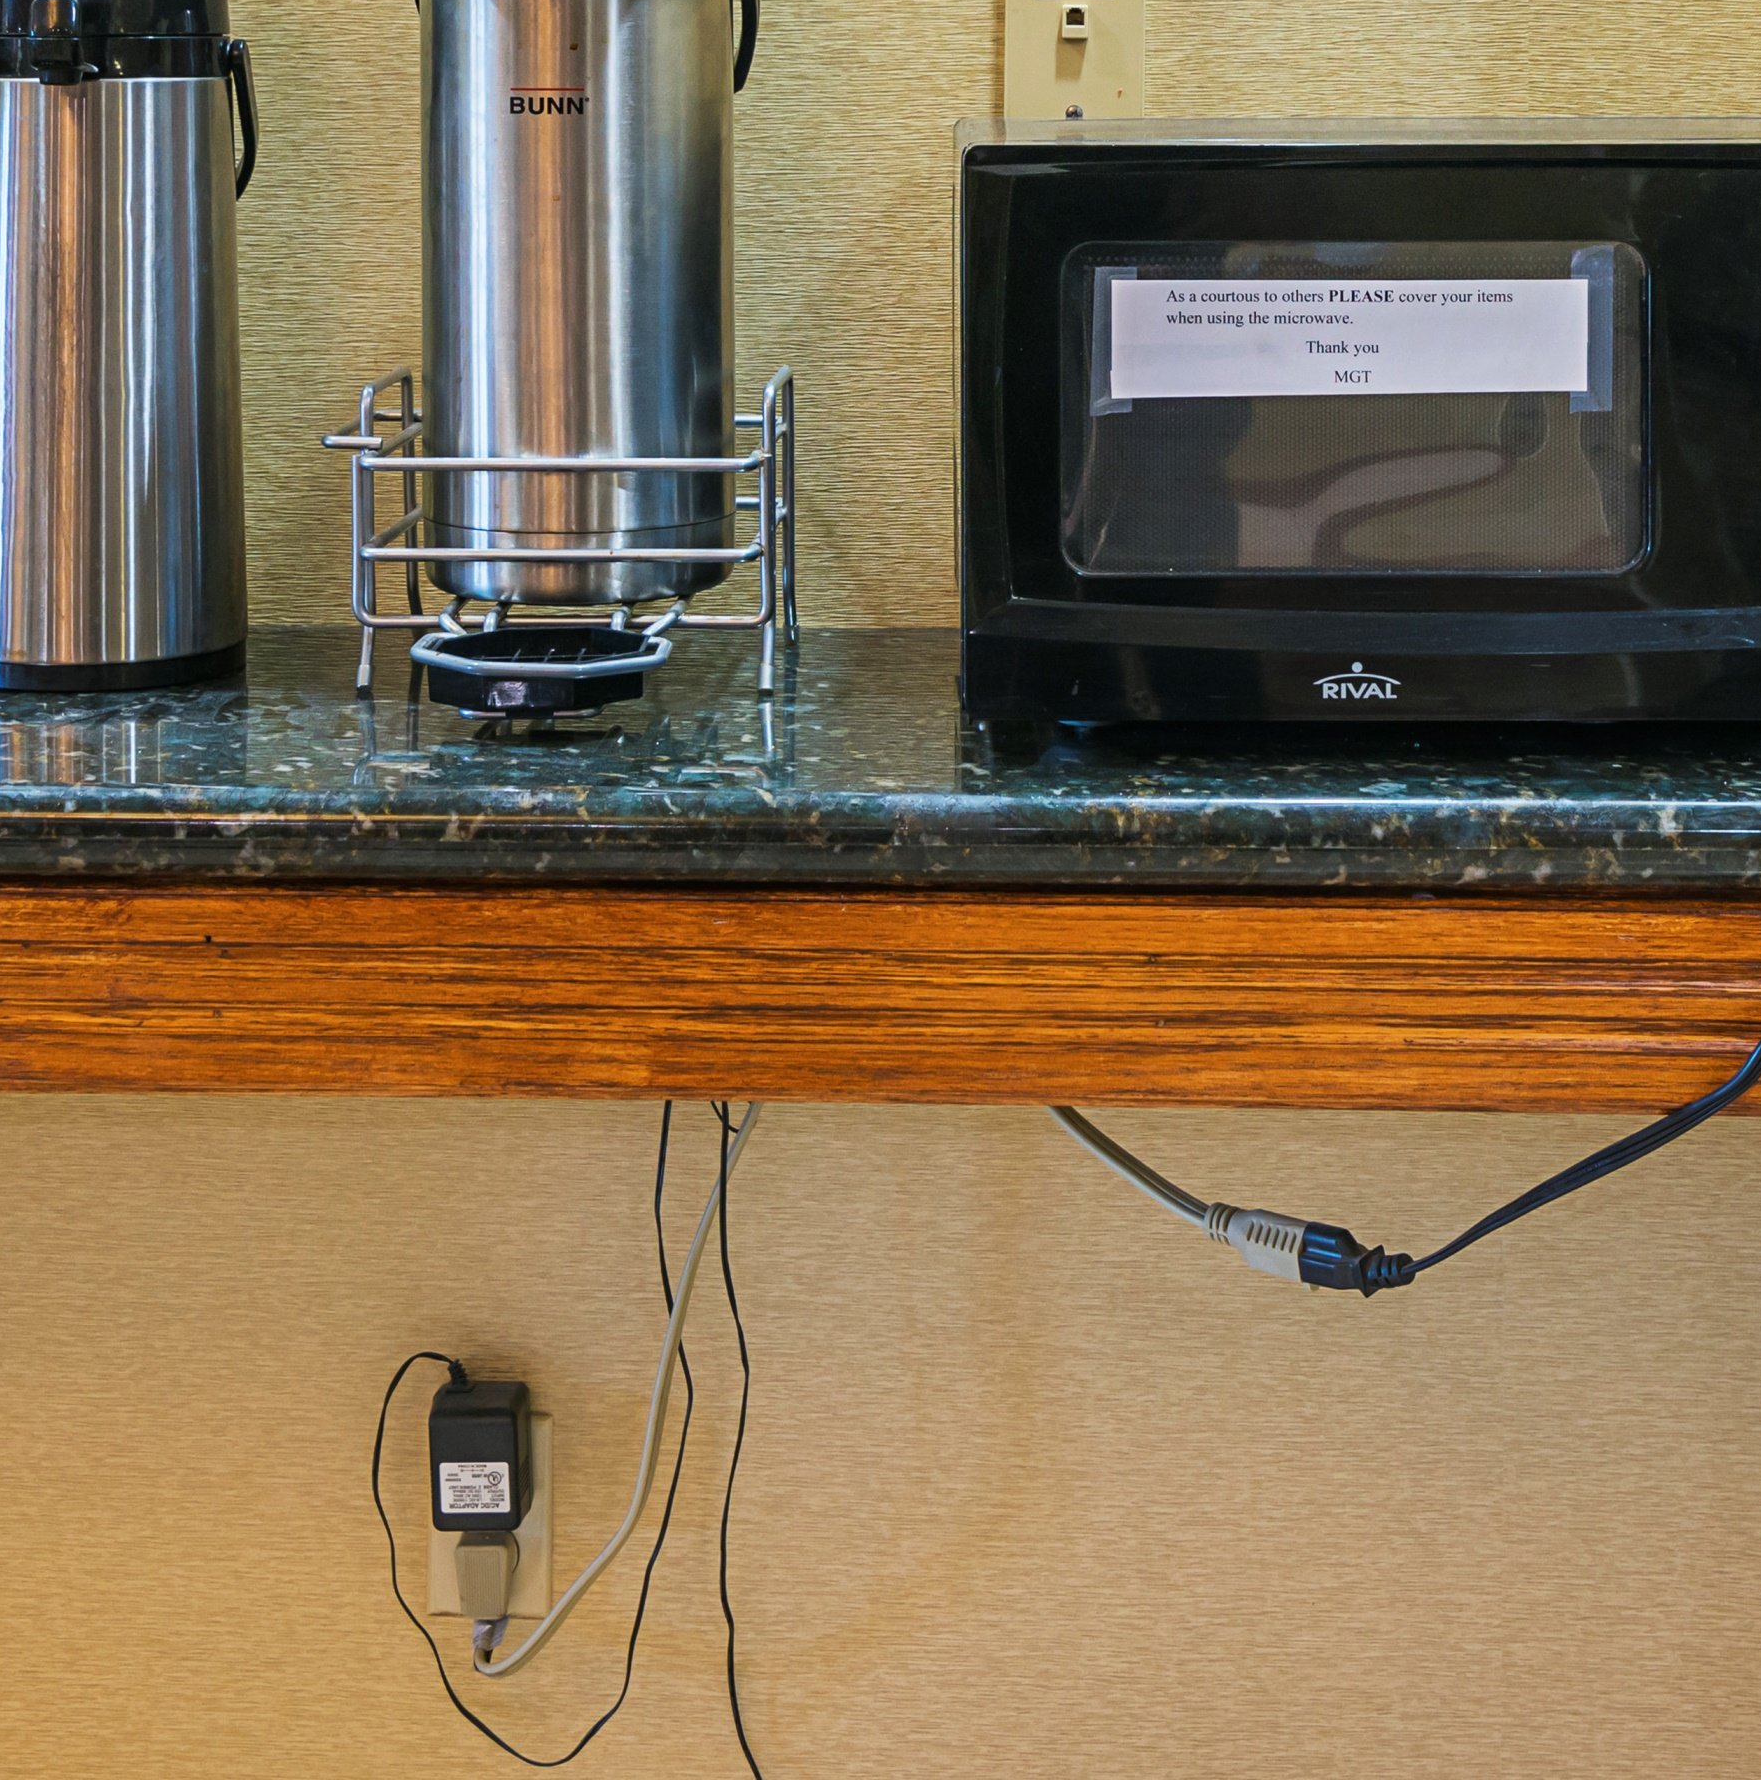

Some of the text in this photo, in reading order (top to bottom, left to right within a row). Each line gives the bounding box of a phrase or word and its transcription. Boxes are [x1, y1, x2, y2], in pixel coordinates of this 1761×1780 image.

[509, 96, 585, 116] BUNN
[1166, 289, 1513, 306] As a courtous to others PLEASE cover your items
[1166, 311, 1354, 328] when using the microwave.
[1305, 340, 1379, 357] Thank you
[1334, 370, 1372, 384] MGT
[1321, 682, 1398, 699] RIVAL
